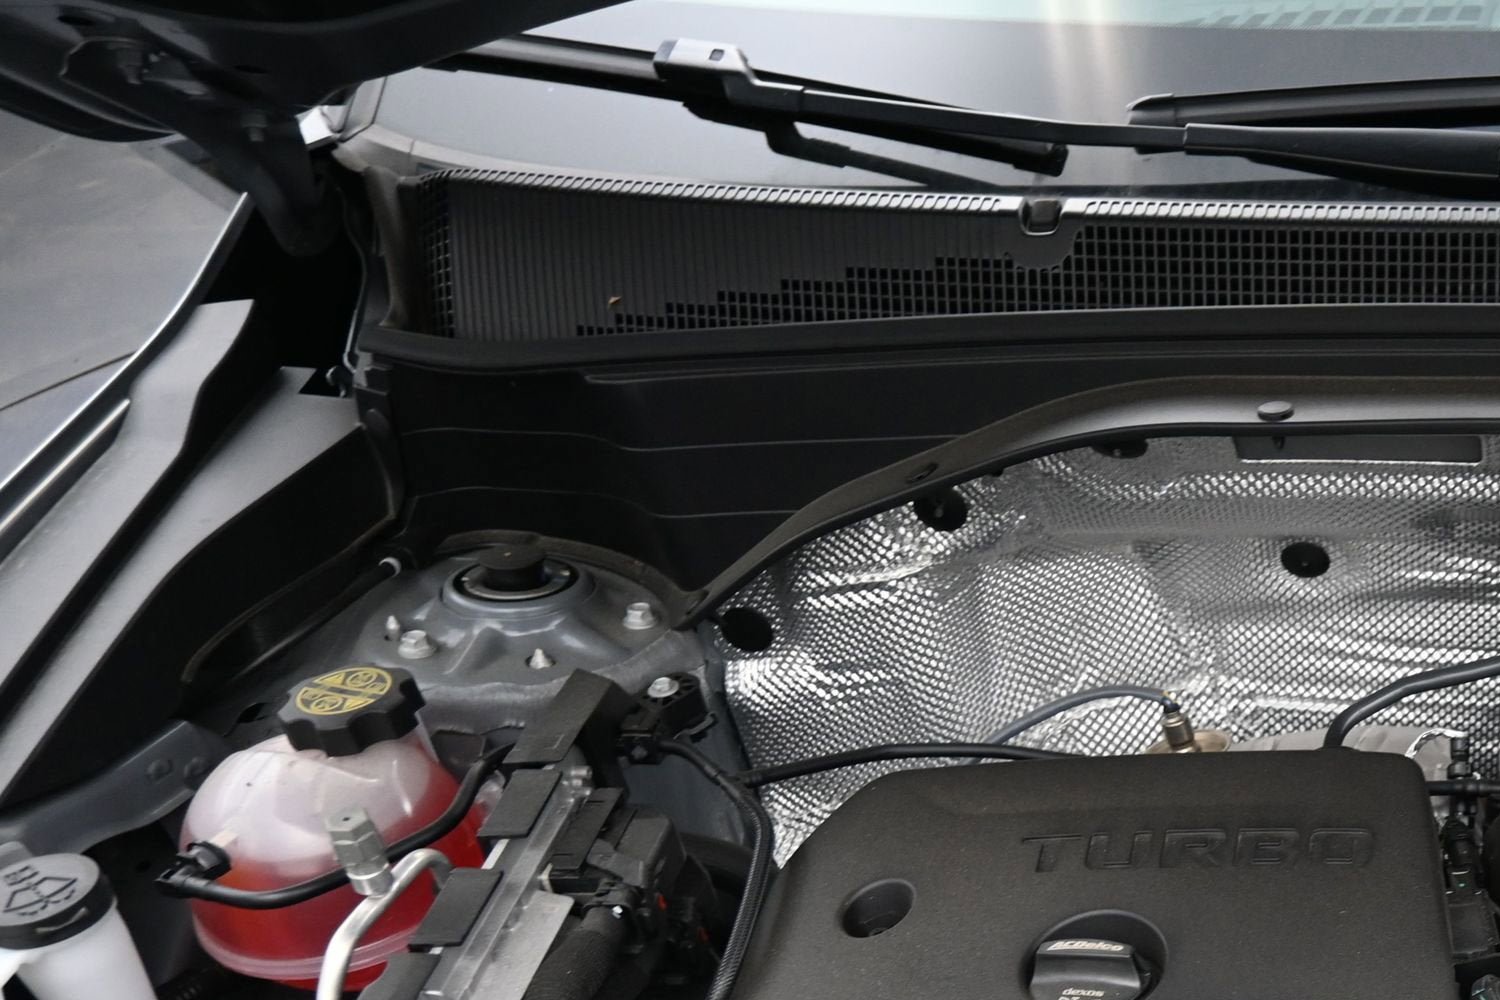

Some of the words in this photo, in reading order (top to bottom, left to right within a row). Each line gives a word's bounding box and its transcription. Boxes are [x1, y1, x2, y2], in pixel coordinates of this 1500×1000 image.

[1021, 827, 1375, 873] TURBO
[1046, 940, 1124, 952] ACDelco
[1062, 987, 1105, 997] dexos
